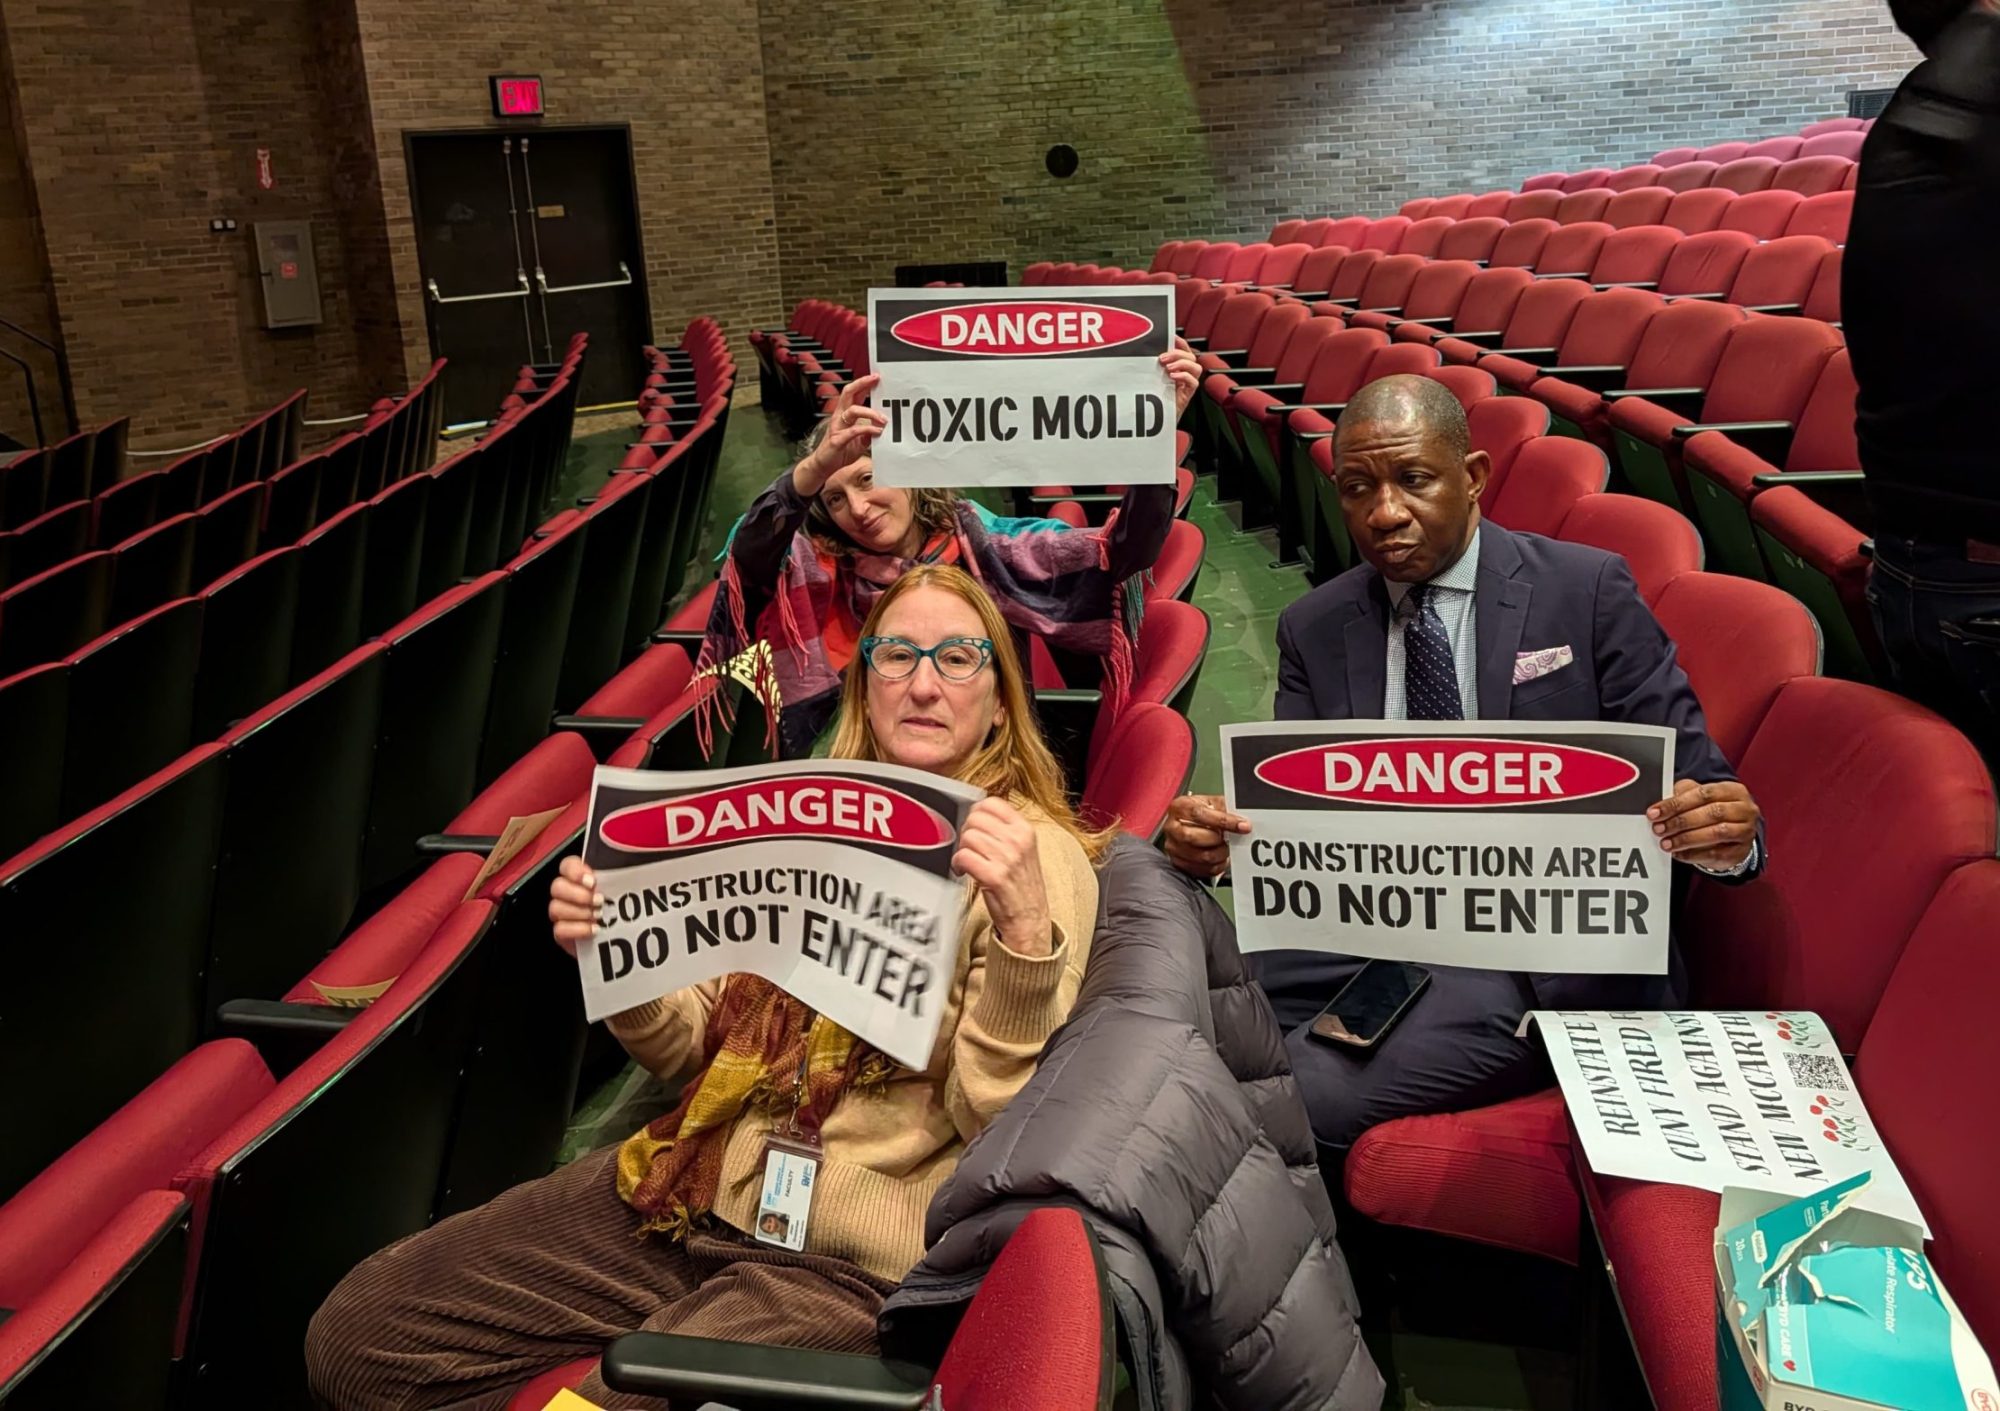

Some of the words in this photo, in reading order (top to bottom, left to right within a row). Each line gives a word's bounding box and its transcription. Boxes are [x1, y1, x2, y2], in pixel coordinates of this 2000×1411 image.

[501, 79, 540, 113] EXIT
[940, 311, 1105, 346] DANGER
[882, 396, 1018, 442] TOXIC
[1032, 393, 1164, 440] MOLD
[1323, 751, 1564, 794] DANGER
[665, 787, 894, 846] DANGER
[1250, 838, 1534, 878] CONSTRUCTION
[1544, 846, 1649, 879] AREA
[599, 867, 863, 929] CONSTRUCTION
[864, 891, 942, 946] AREA
[1252, 876, 1322, 920] DO
[1338, 882, 1447, 931] NOT
[1464, 887, 1649, 936] ENTER
[598, 926, 669, 983] DO
[685, 903, 789, 955] NOT
[801, 908, 936, 1017] ENTER
[1563, 1021, 1642, 1137] REINSTATE
[1618, 1026, 1676, 1098] FIRED
[1663, 1011, 1732, 1097] AGAINST
[1647, 1101, 1707, 1162] CUNY
[1707, 1103, 1772, 1176] STAND
[1769, 1129, 1830, 1183] NEW
[785, 1168, 794, 1198] FACULTY
[1883, 1277, 1898, 1335] Respirator
